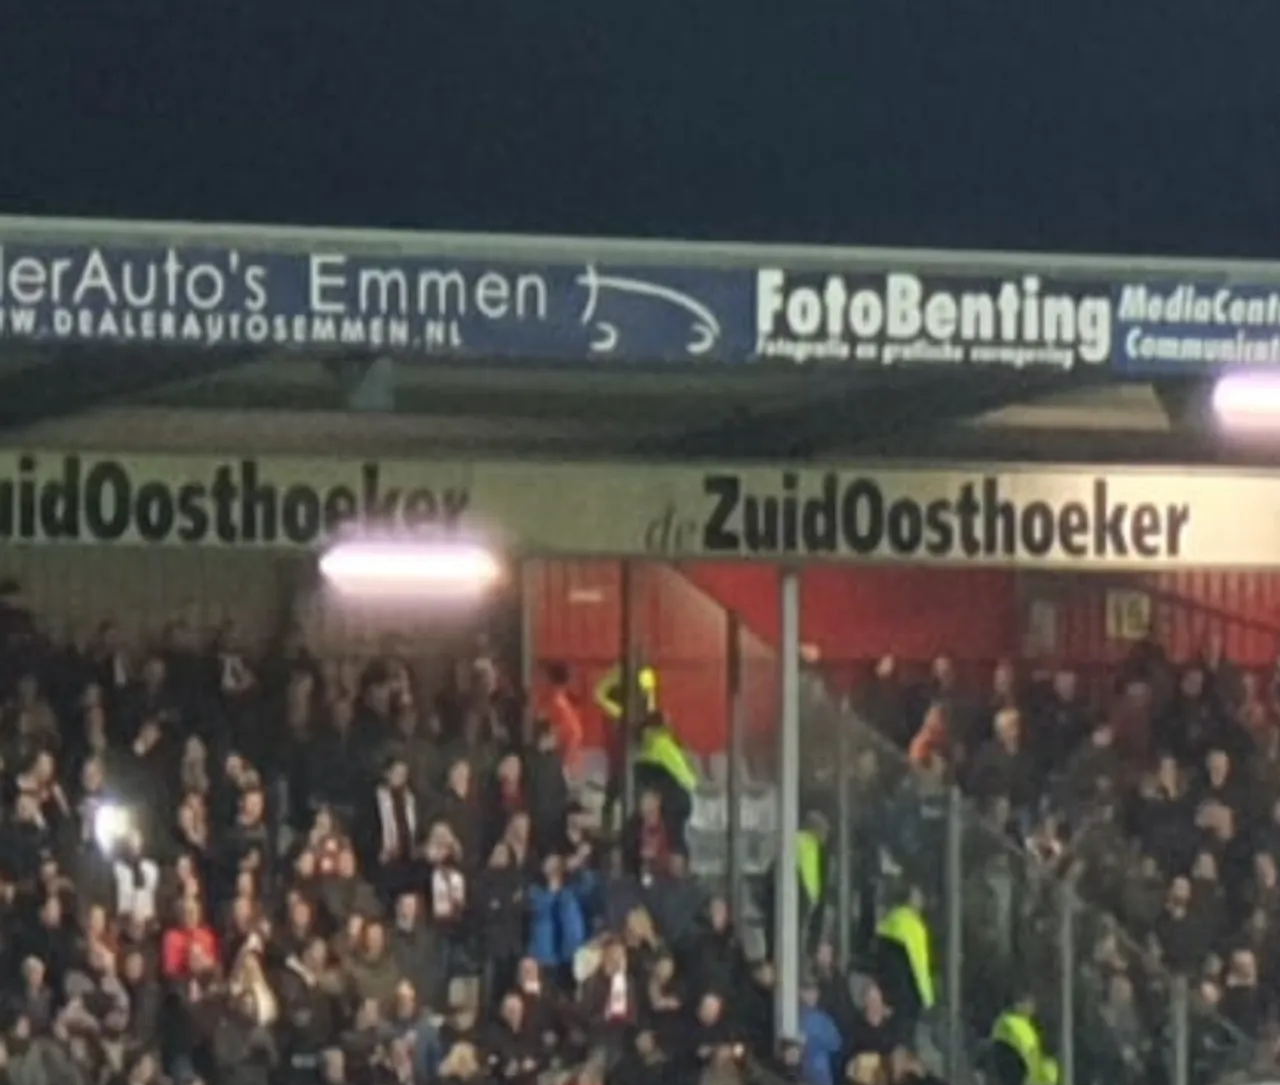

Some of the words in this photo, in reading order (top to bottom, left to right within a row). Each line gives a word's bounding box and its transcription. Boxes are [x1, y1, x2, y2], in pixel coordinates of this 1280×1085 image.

[309, 253, 548, 320] Emmen
[757, 268, 1111, 363] FotoBenting
[703, 471, 1191, 558] ZuidOosthoeker
